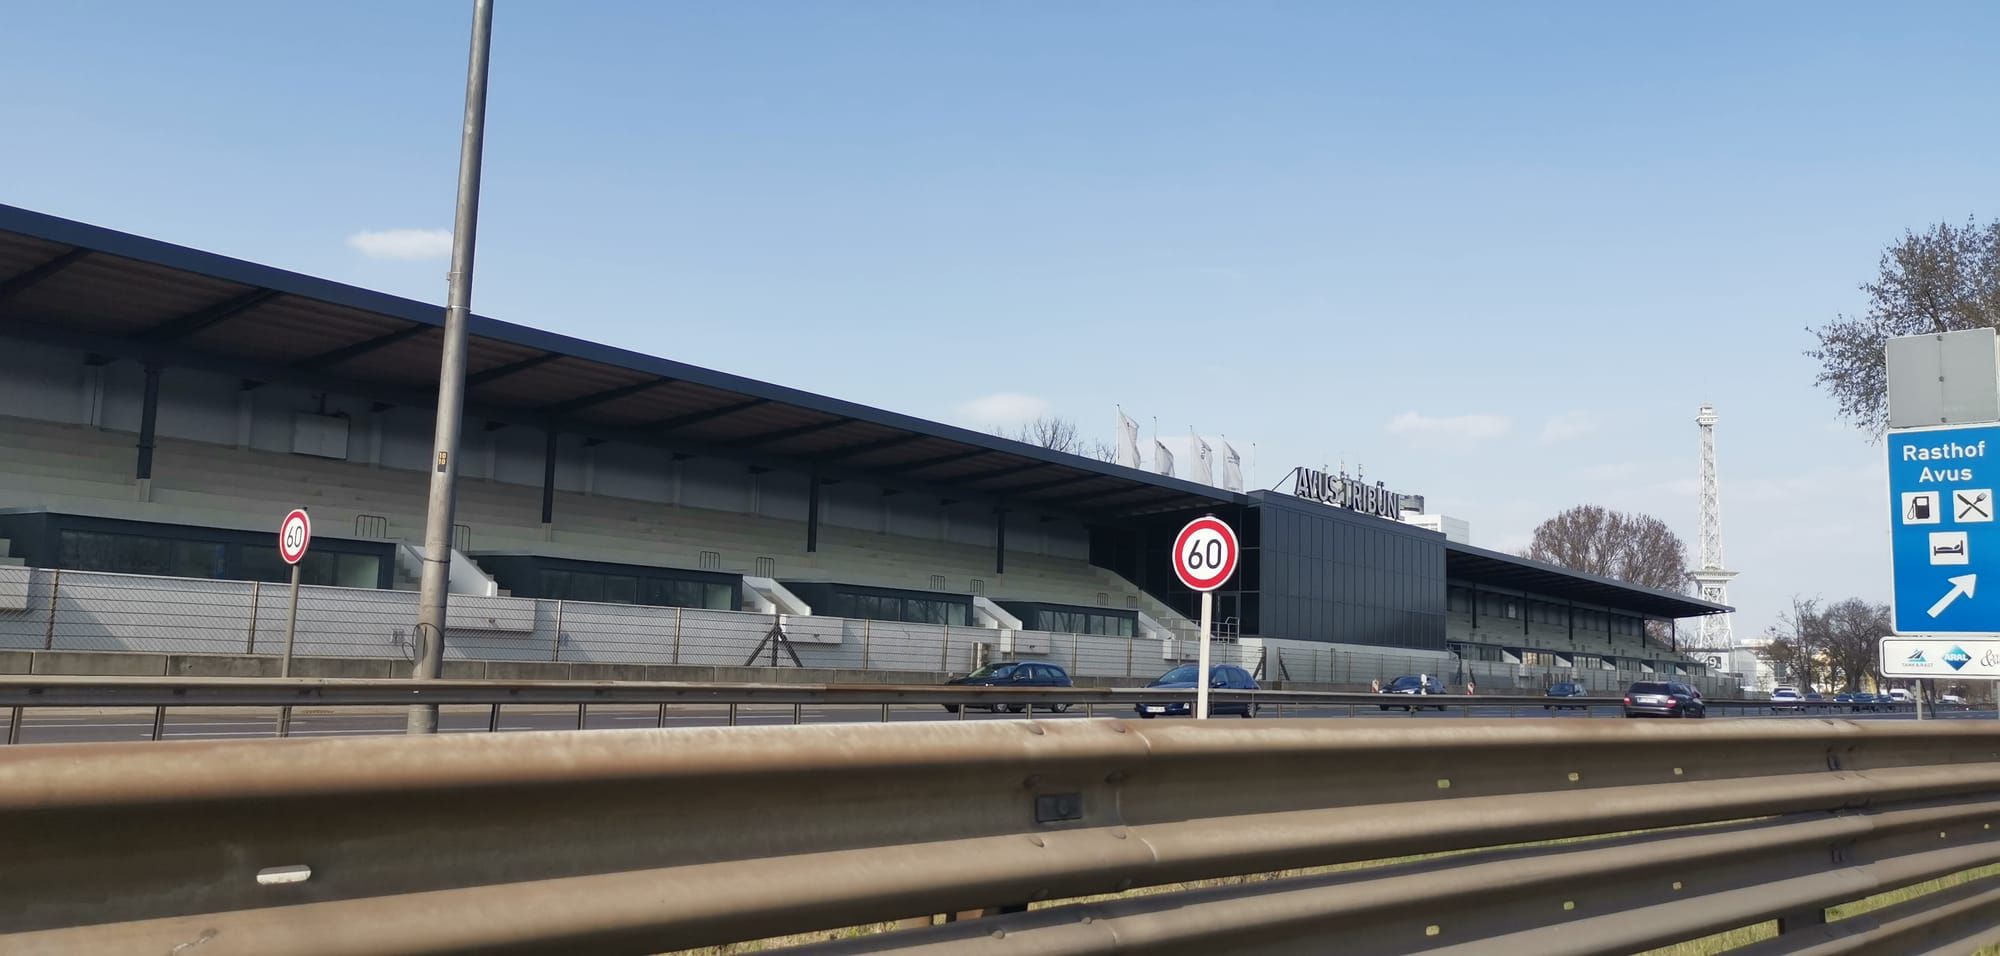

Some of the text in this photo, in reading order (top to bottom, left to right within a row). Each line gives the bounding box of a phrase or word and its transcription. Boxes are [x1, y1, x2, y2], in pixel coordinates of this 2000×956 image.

[1903, 441, 1985, 461] Rasthof
[1919, 467, 1973, 482] Avus
[1294, 467, 1340, 504] AVUS
[287, 526, 302, 548] 60
[1188, 539, 1222, 569] 60
[1944, 654, 1968, 662] ARAL
